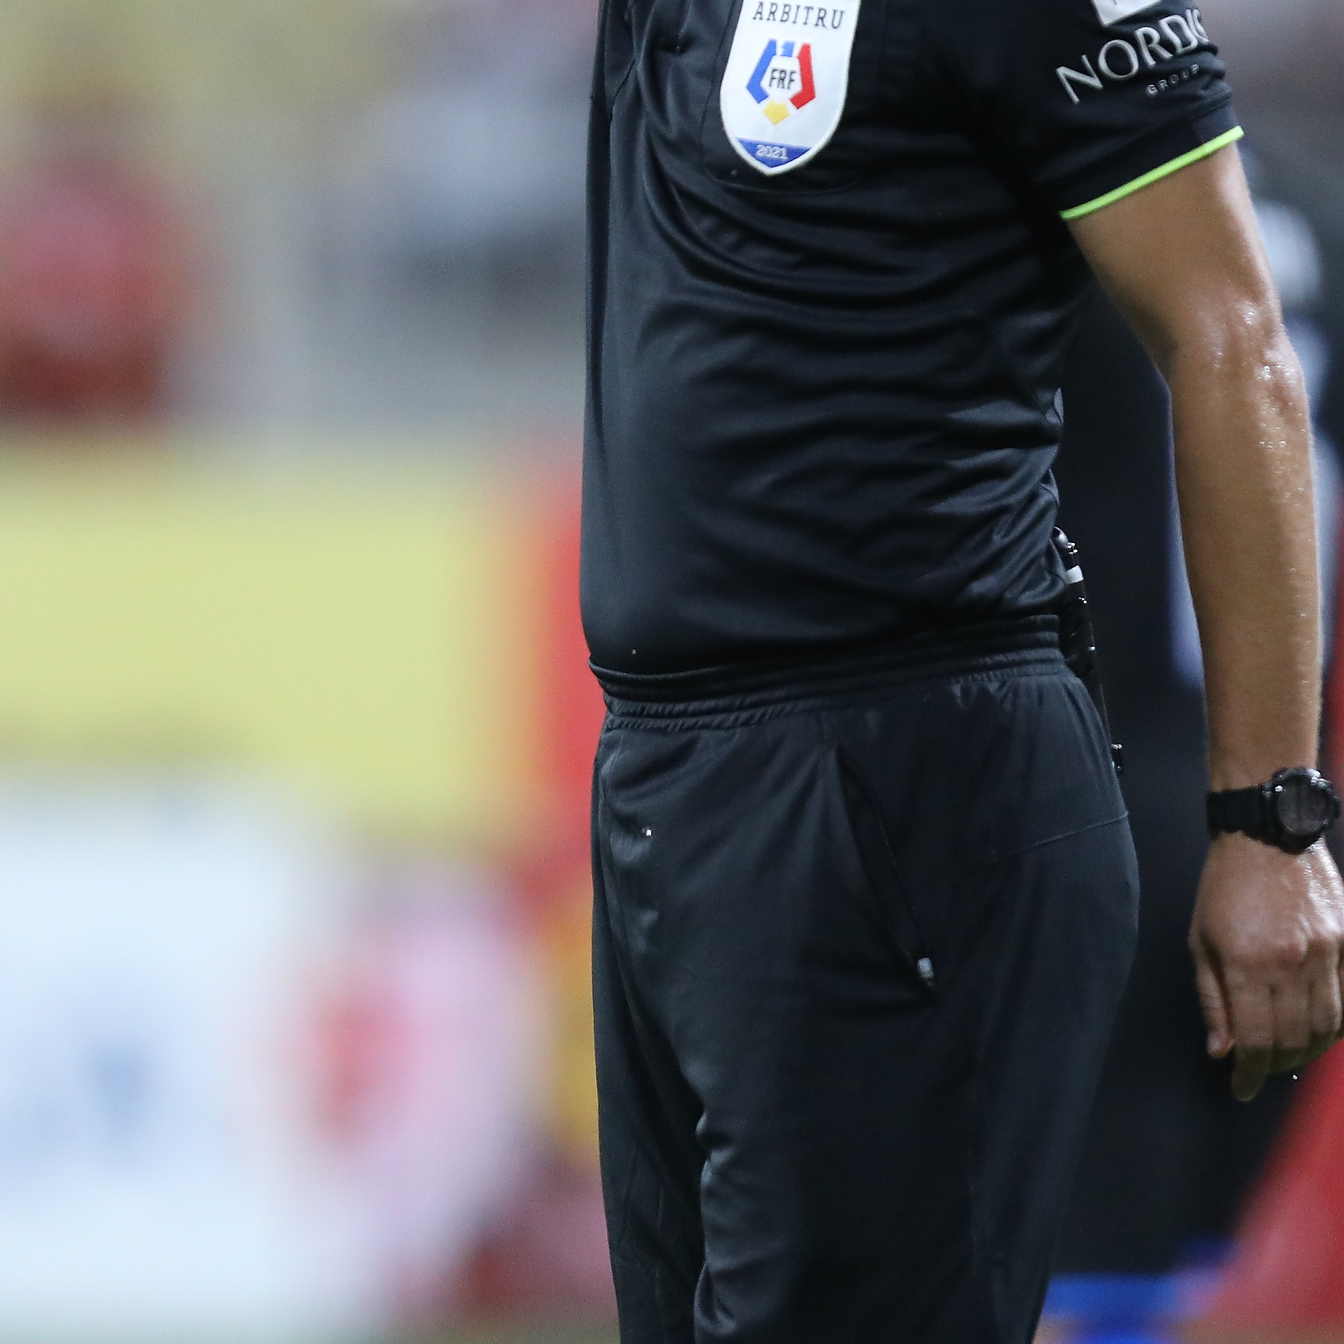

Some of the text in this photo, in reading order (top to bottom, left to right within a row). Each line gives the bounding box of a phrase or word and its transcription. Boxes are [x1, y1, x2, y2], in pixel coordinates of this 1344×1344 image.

[752, 1, 846, 30] ARBITRU
[768, 67, 798, 90] FRF
[1146, 63, 1201, 96] GROUP
[755, 144, 789, 160] 2021
